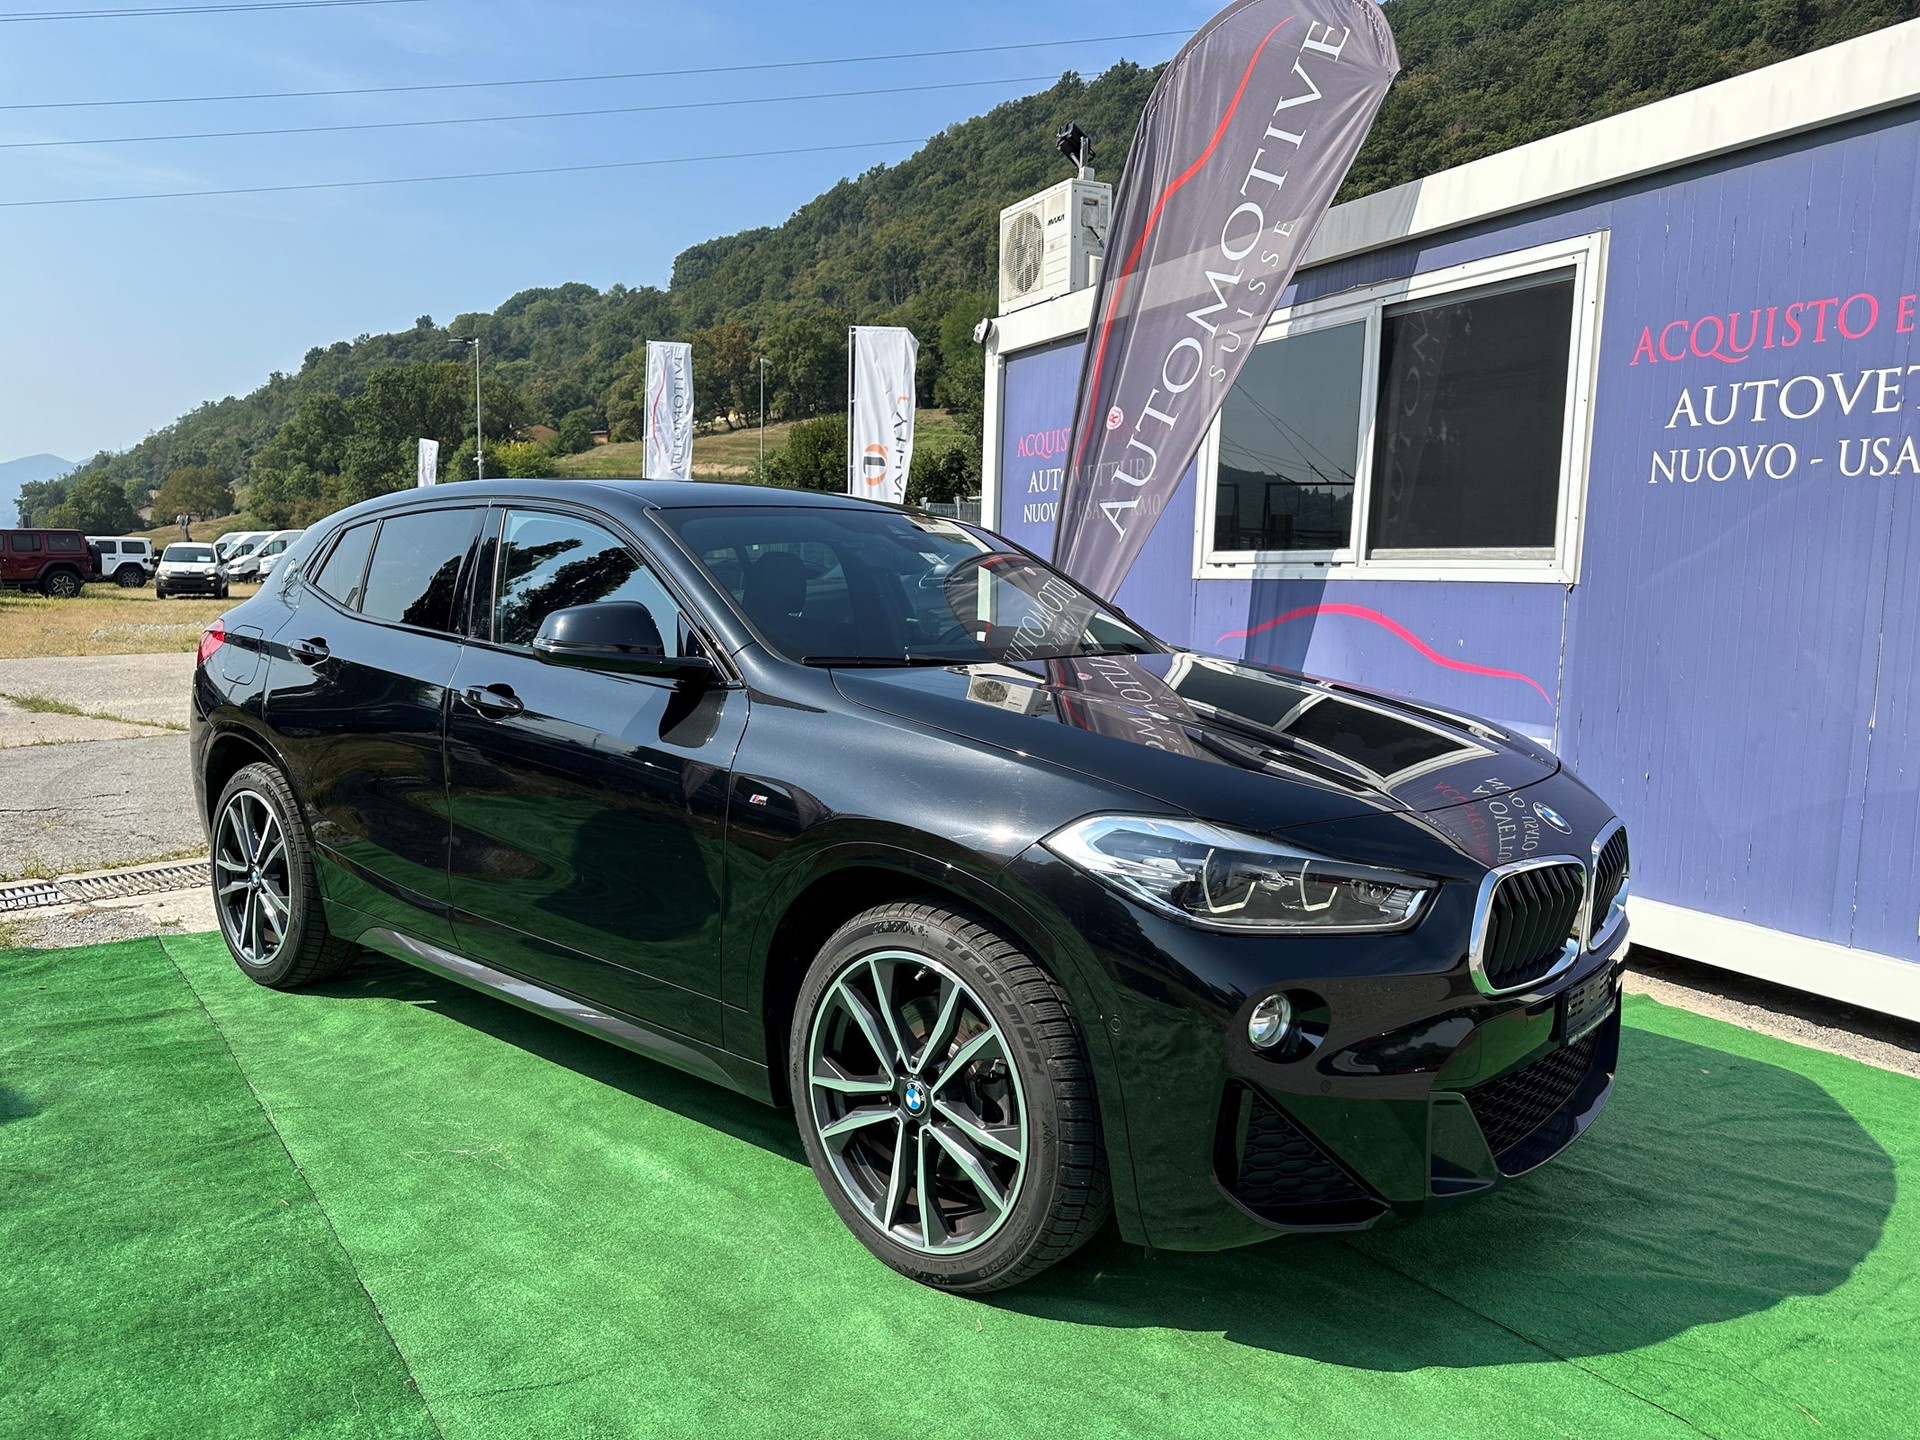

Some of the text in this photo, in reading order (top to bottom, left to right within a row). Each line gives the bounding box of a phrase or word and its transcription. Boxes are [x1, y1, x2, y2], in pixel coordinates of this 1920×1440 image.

[1099, 20, 1352, 543] AUTOMOTIVE
[1208, 220, 1294, 382] SUISSE
[1629, 292, 1917, 366] ACQUISTO E
[1017, 428, 1071, 459] ACQUIS
[1648, 442, 1797, 484] NUOVO
